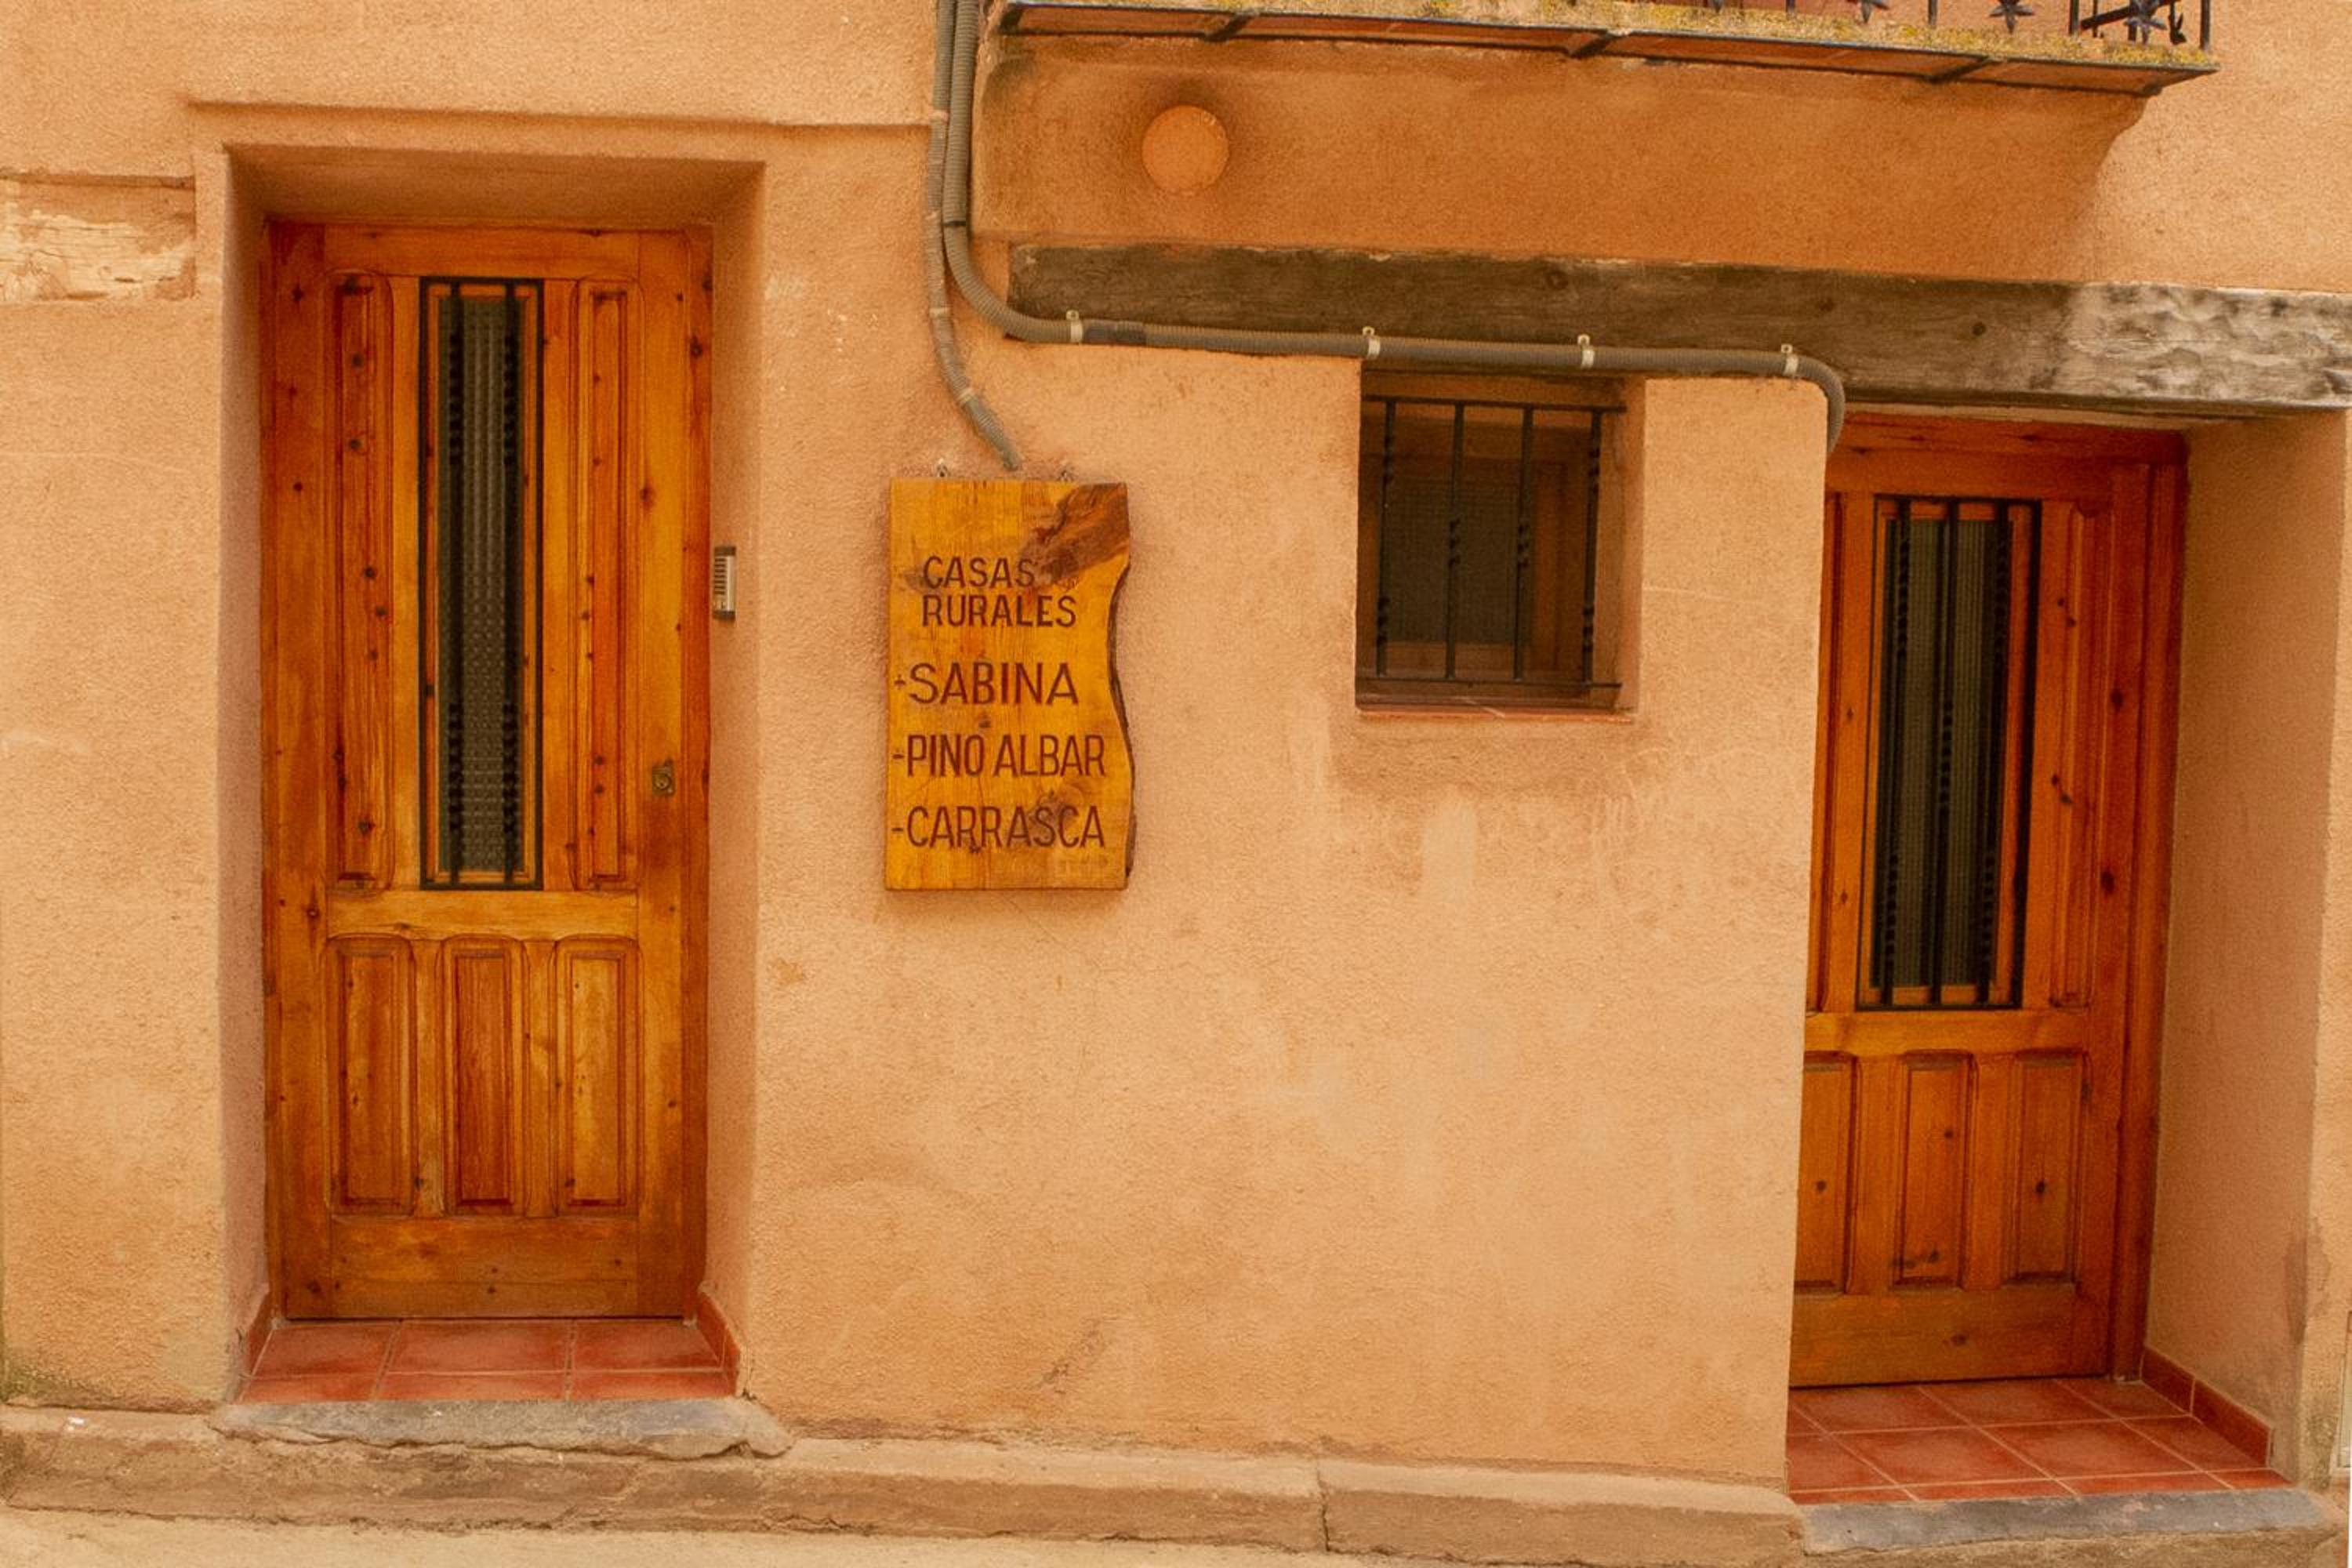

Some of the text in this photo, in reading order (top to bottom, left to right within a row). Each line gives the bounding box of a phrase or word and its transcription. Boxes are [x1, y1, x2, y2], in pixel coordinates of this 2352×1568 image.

[923, 555, 1036, 590] CASAS
[922, 594, 1077, 628] RURALES
[993, 734, 1106, 778] ALBAR
